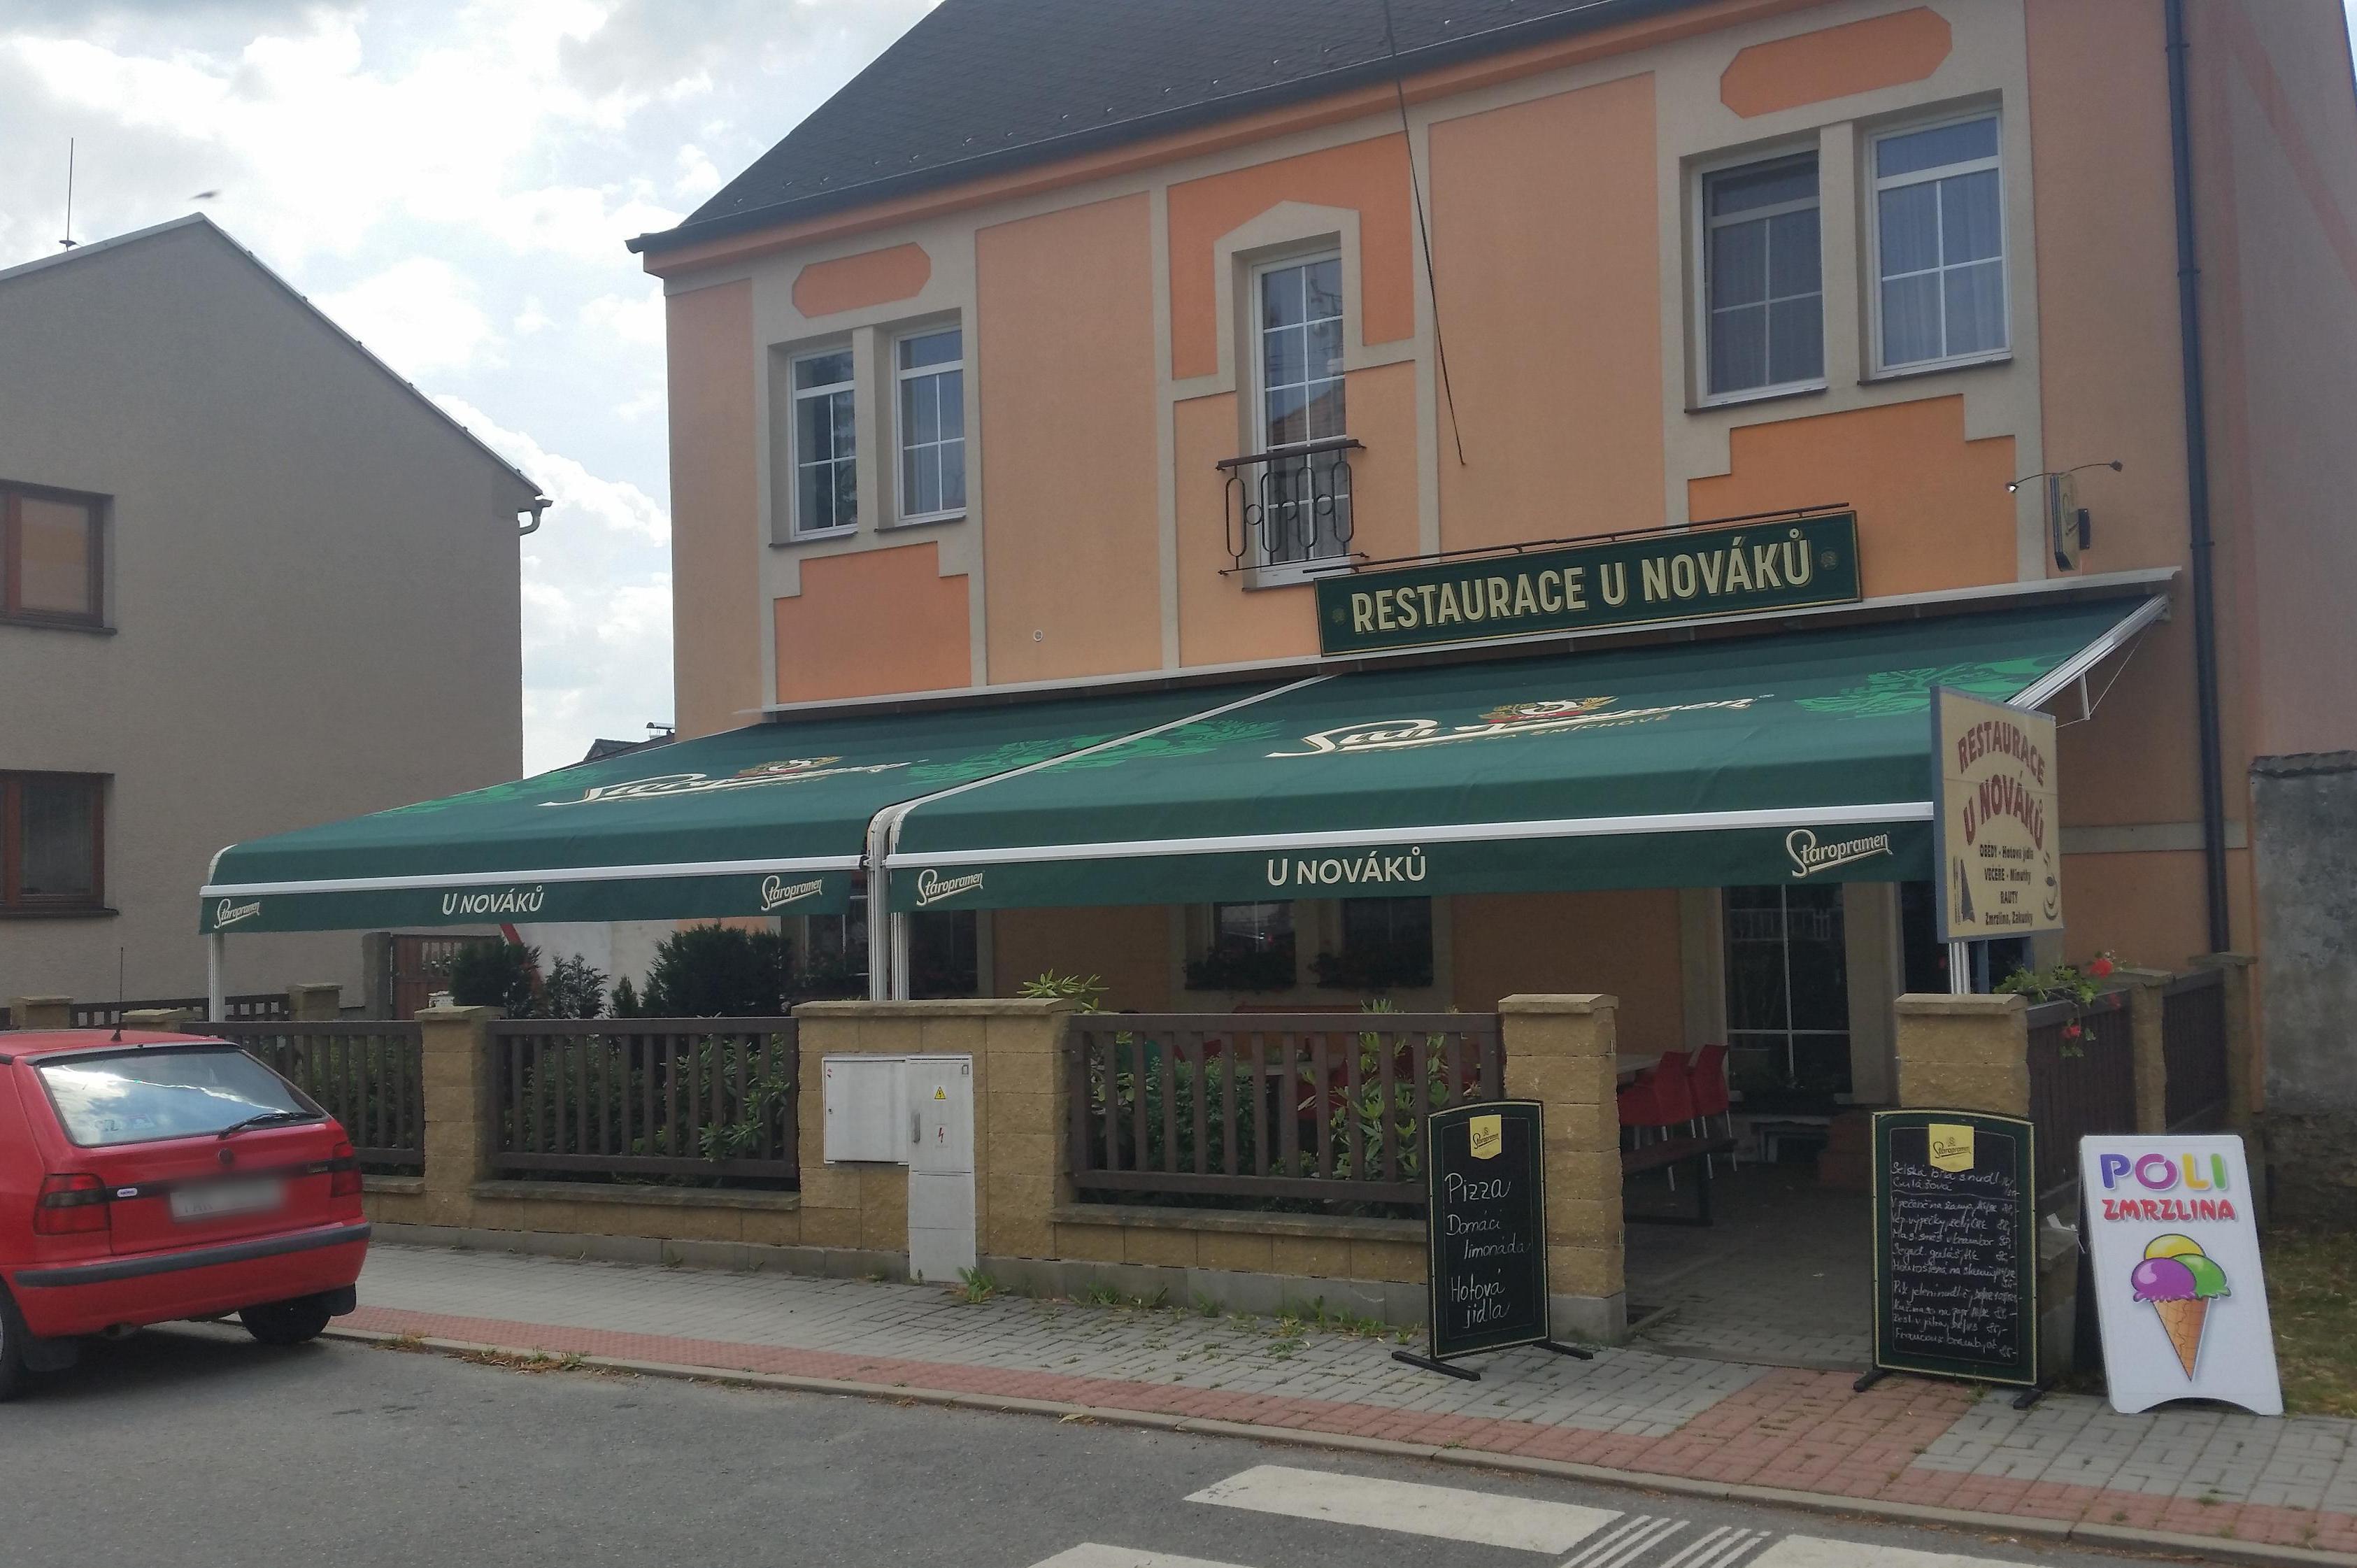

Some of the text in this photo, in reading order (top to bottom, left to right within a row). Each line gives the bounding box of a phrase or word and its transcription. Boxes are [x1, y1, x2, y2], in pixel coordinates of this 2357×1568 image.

[1351, 529, 1812, 633] RESTAURACE U NOVÁKŮ
[1958, 721, 2045, 787] RESTAURACE
[1963, 771, 2045, 850] U NOVÁKŮ
[1268, 846, 1426, 886] U NOVÁKŮ
[1786, 829, 1893, 878] Staropramen
[442, 885, 544, 915] U NOVÁKŮ
[761, 875, 823, 911] Staropramen
[916, 869, 983, 906] Staropramen
[2000, 891, 2018, 904] RAUTY
[213, 898, 260, 929] Staropramen
[1932, 1141, 1972, 1159] Staropramen
[1444, 1172, 1511, 1204] Pizza
[2100, 1153, 2229, 1190] POLI
[1446, 1209, 1501, 1236] Domácí
[2102, 1199, 2237, 1222] ZMRZLINA
[1465, 1232, 1531, 1260] limonáda
[1451, 1268, 1504, 1302] Hotová
